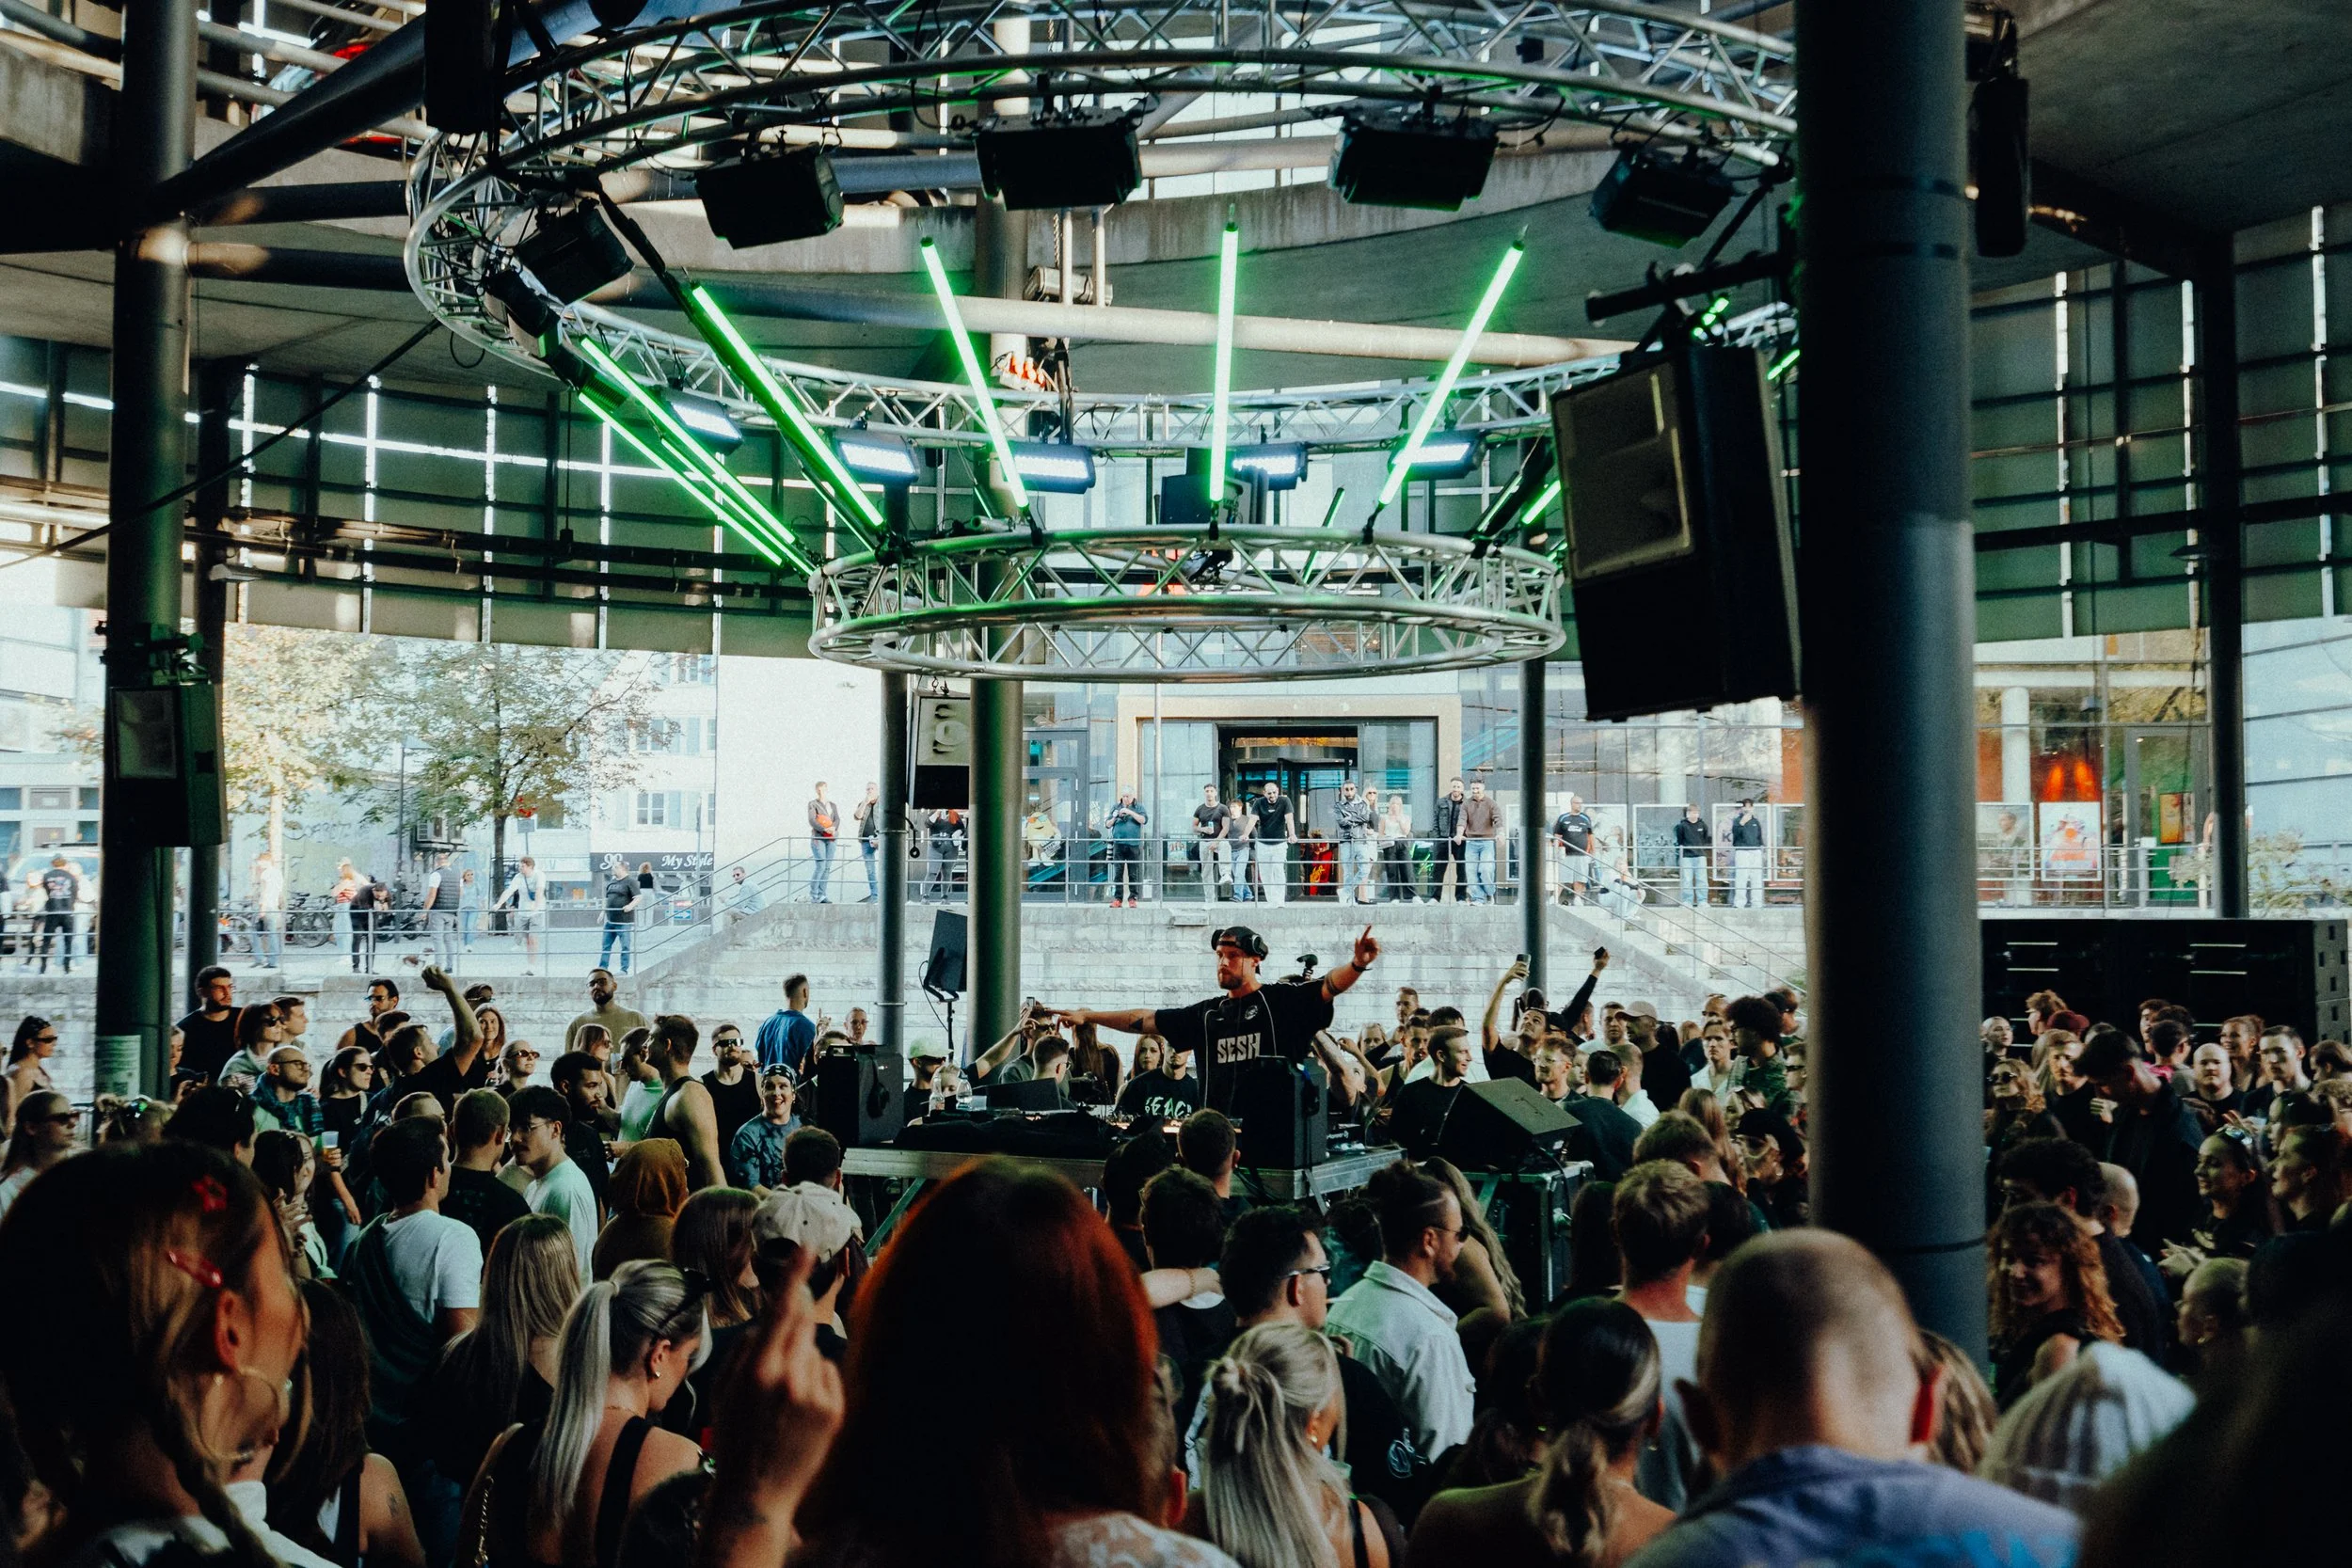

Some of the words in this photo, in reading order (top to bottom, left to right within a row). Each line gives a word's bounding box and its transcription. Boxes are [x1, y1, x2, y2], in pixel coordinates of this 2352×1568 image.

[661, 855, 683, 870] My
[683, 853, 713, 870] Style
[1217, 1032, 1261, 1064] SESH
